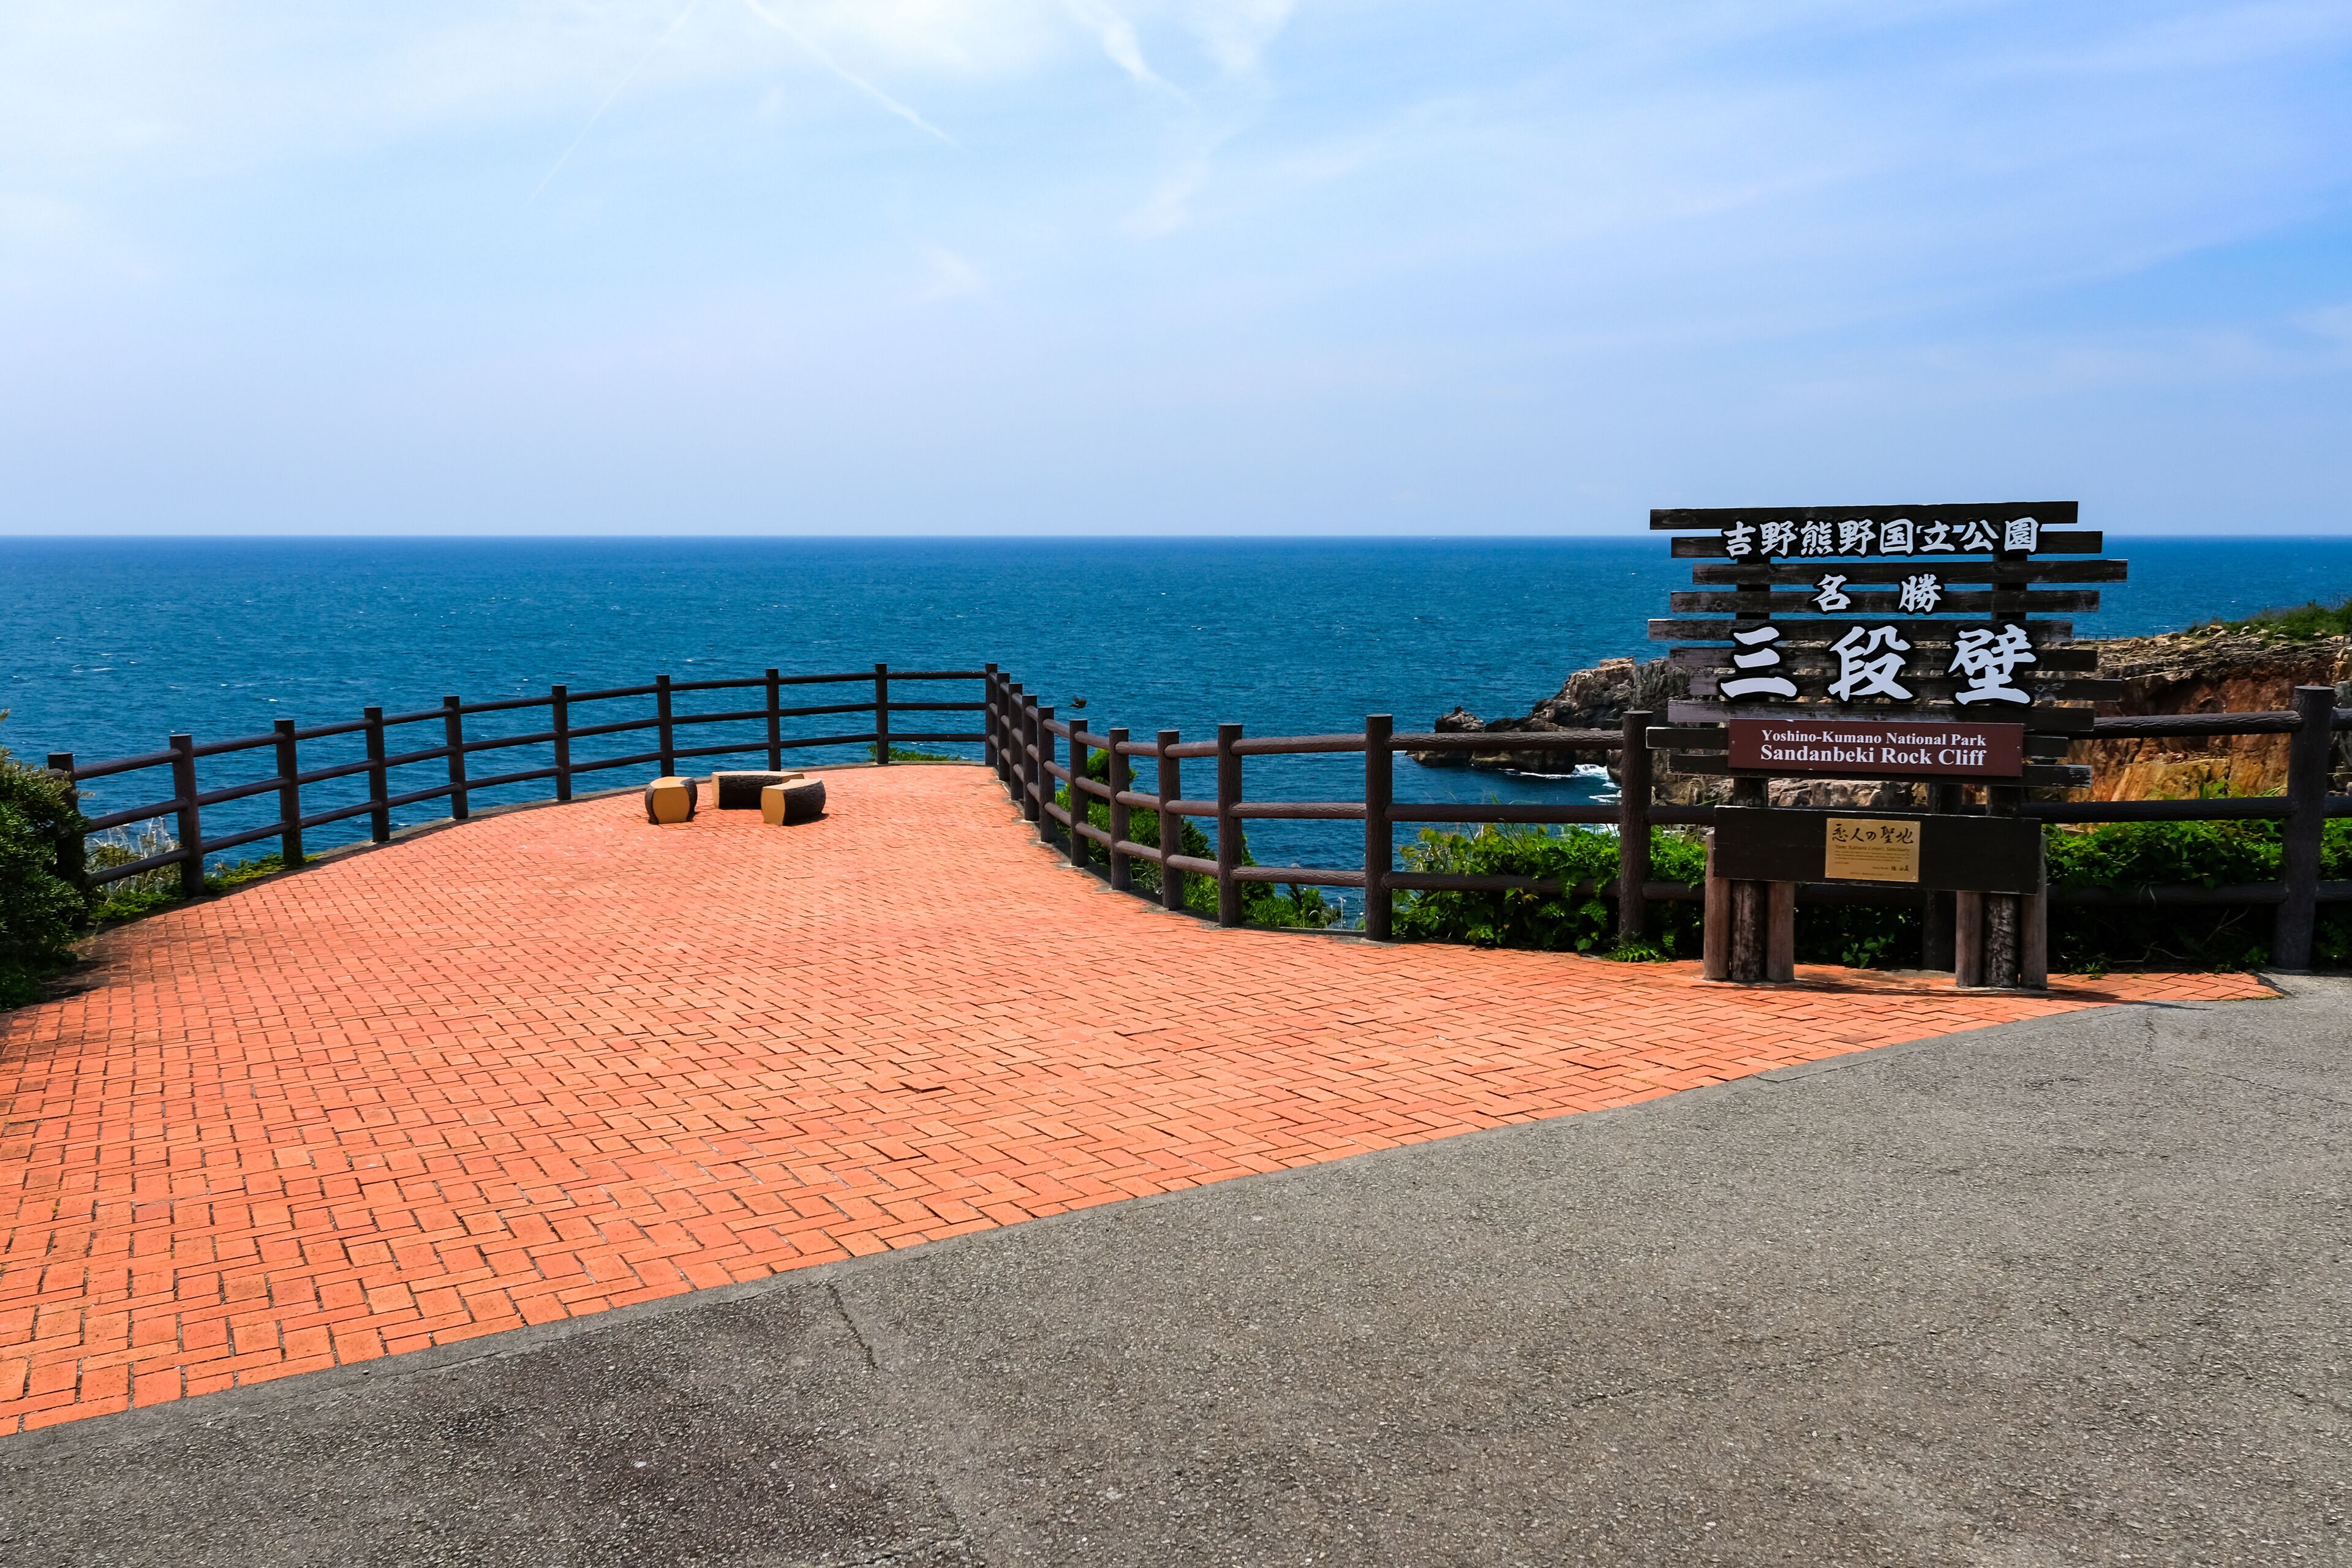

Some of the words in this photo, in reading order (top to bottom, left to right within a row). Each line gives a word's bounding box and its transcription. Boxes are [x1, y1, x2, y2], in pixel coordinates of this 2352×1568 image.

[1724, 516, 2039, 557] 吉野熊野国立公園
[1720, 624, 2036, 705] 三段壁
[1762, 730, 1882, 744] Yoshino-Kumano
[1887, 733, 1946, 745] National
[1951, 734, 1986, 746] Park
[1760, 745, 1874, 763] Sandanbeki
[1881, 747, 1932, 764] Rock
[1939, 749, 1987, 766] Cliff
[1832, 823, 1913, 844] 恋人の聖地
